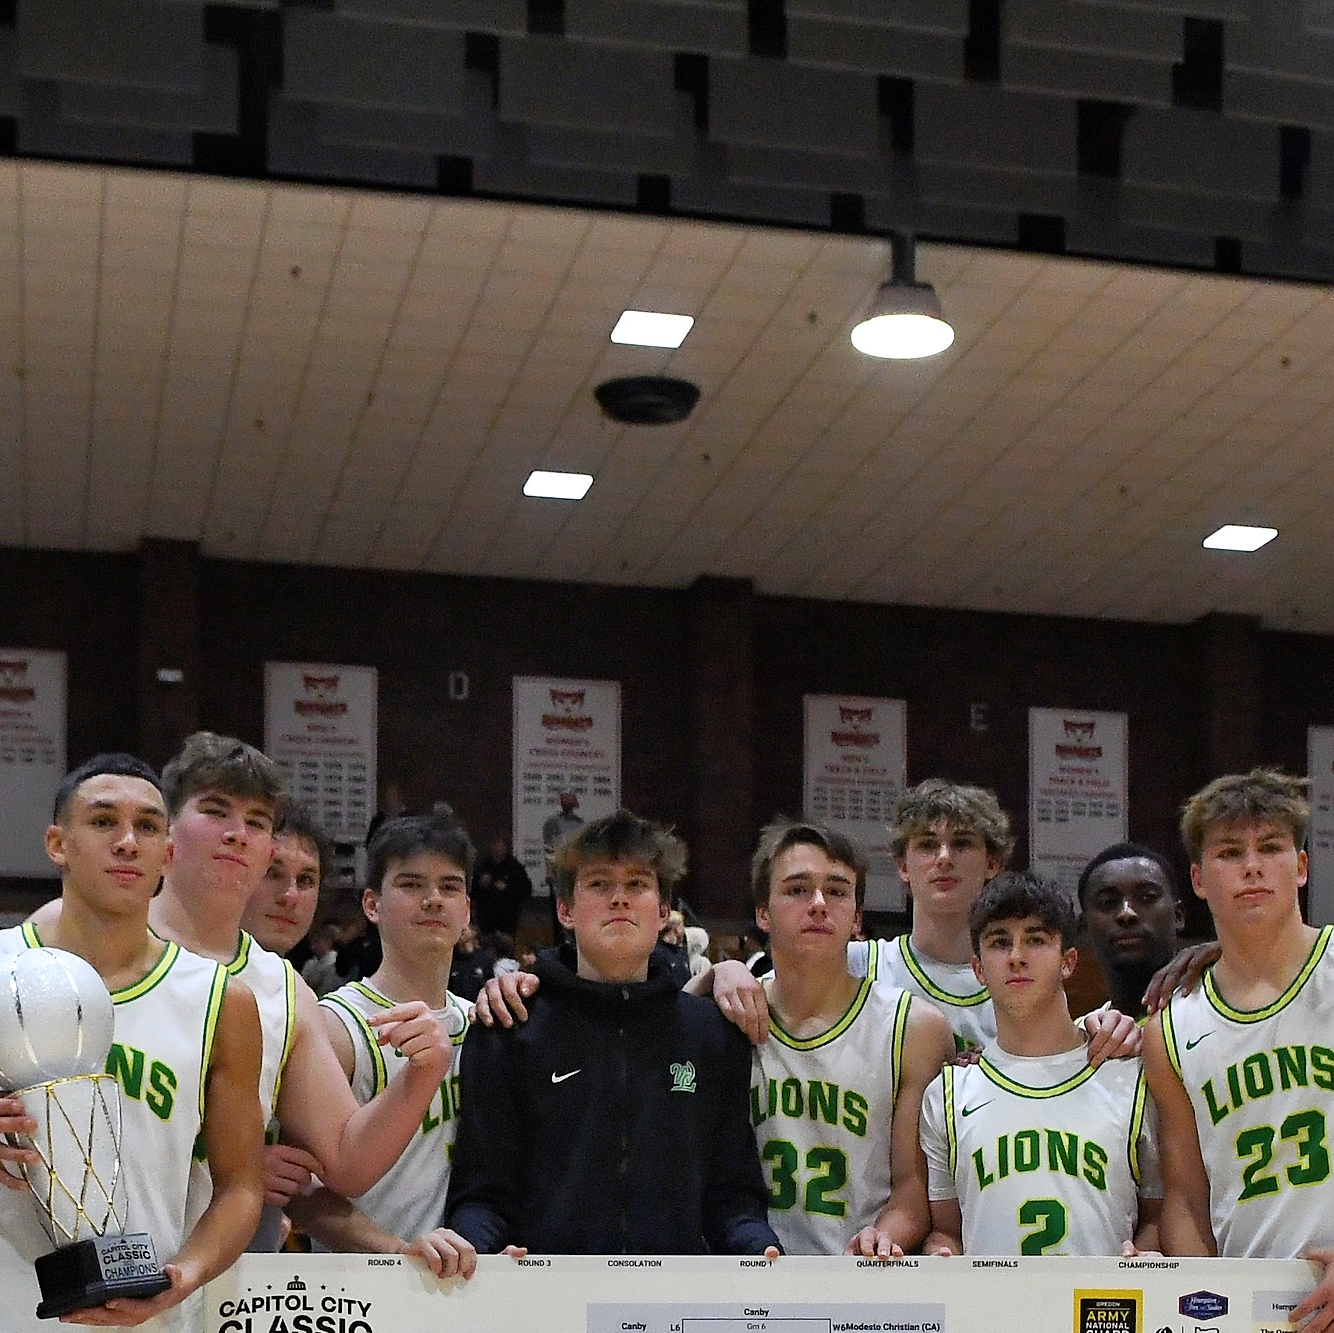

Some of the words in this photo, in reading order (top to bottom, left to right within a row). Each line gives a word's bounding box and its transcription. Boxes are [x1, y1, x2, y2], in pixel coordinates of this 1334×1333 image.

[749, 1076, 869, 1138] LIONS
[972, 1128, 1109, 1192] LIONS
[1234, 1107, 1333, 1202] 23
[762, 1138, 849, 1218] 32
[1017, 1198, 1069, 1256] 2
[101, 1244, 130, 1255] CAPITOL
[103, 1250, 151, 1265] CLASSIC
[740, 1260, 767, 1268] ROUND
[857, 1259, 919, 1267] QUARTERFINALS
[104, 1263, 157, 1280] CHAMPIONS
[219, 1295, 314, 1318] CAPITOL
[321, 1296, 372, 1318] CITY
[744, 1308, 769, 1317] Canby
[1086, 1310, 1130, 1322] ARMY
[622, 1322, 647, 1331] Canby
[1085, 1321, 1130, 1330] NATIONAL
